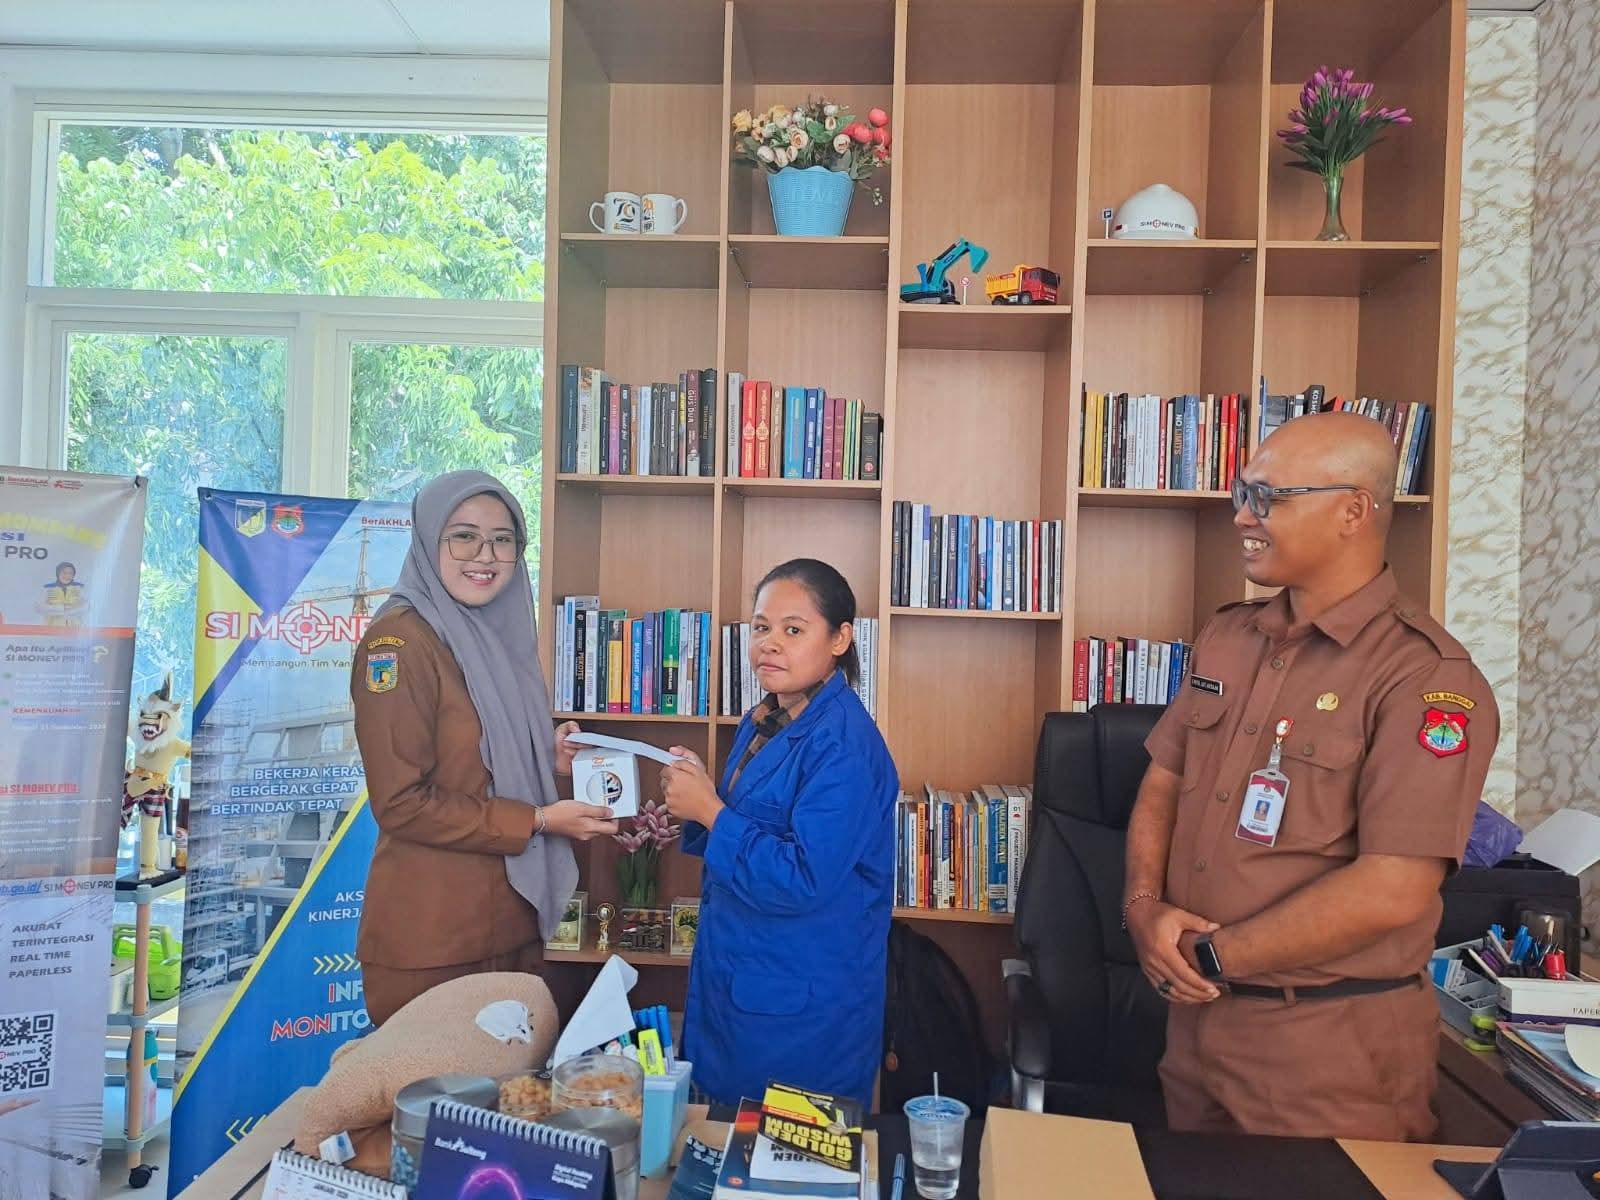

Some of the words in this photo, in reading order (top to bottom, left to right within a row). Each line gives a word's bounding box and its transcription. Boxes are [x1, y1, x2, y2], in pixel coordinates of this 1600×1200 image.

[1175, 413, 1183, 427] NO
[5, 545, 48, 560] PRO
[205, 611, 240, 640] SI
[6, 643, 28, 655] Apa
[242, 659, 307, 669] Membangun
[312, 659, 329, 667] Tim
[255, 769, 319, 780] BEKERJA
[231, 784, 310, 797] BERGERAK
[312, 782, 356, 793] GEPAT
[211, 802, 295, 815] BERTINDAK
[300, 799, 343, 810] TEPAT
[97, 881, 114, 889] PRO
[309, 908, 361, 922] KINERJ
[12, 922, 62, 933] AKURAT
[11, 934, 94, 948] TERINTEGRASI
[10, 954, 41, 963] REAL
[43, 951, 72, 960] TIME
[9, 966, 72, 979] PAPERLESS
[270, 1008, 376, 1041] MONITO
[764, 1115, 853, 1149] WISDOM
[764, 1126, 853, 1162] GOLDEN
